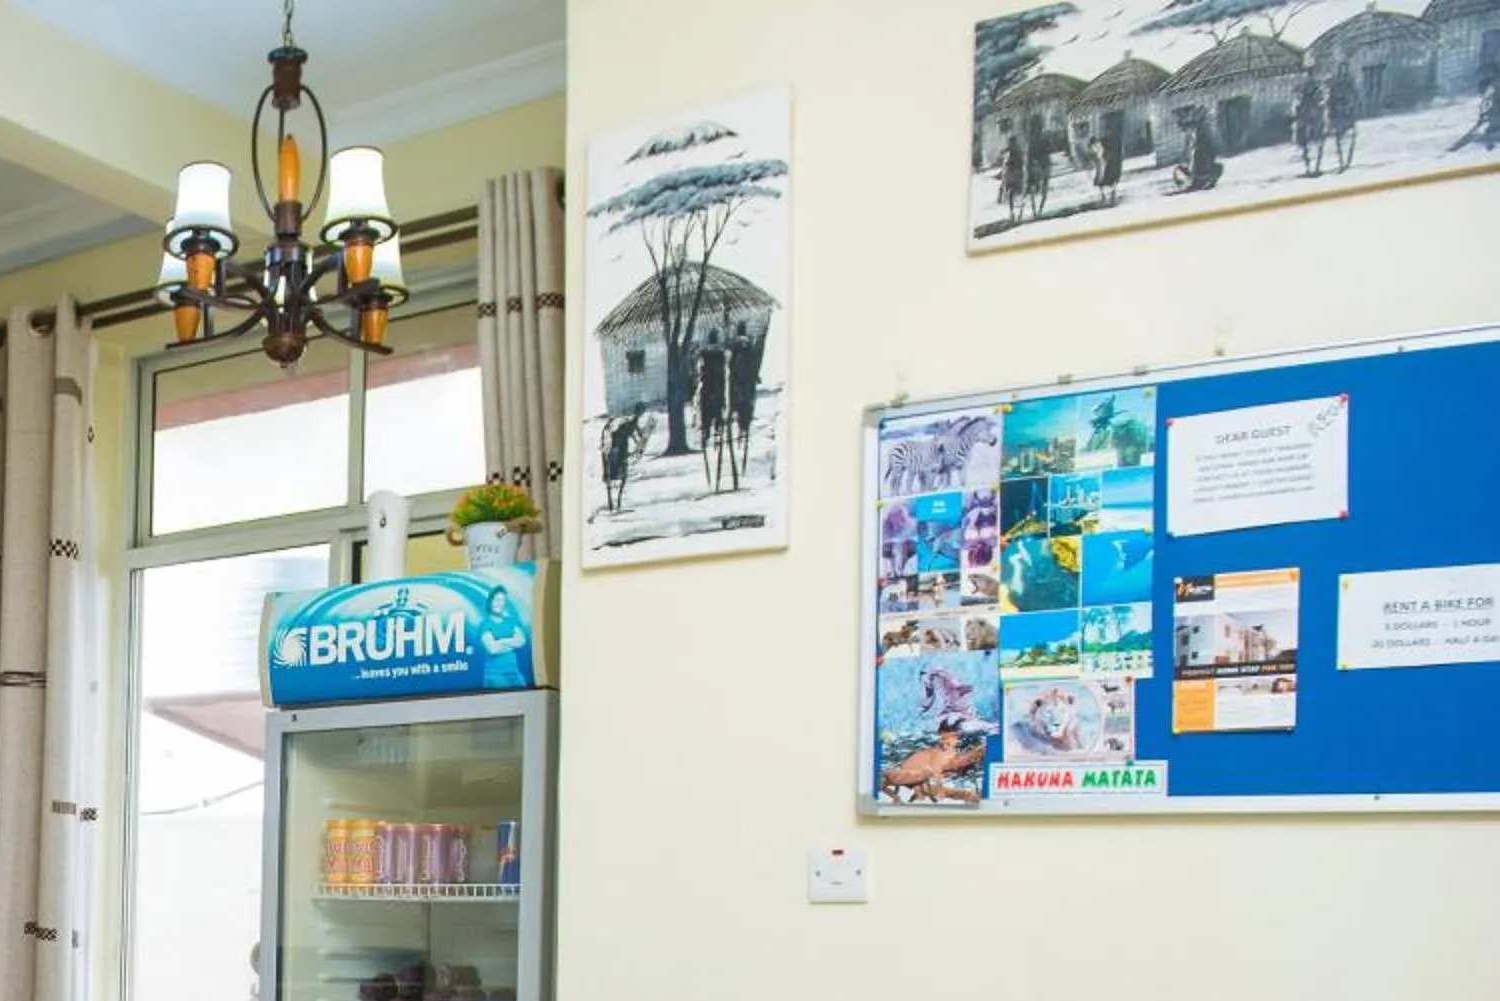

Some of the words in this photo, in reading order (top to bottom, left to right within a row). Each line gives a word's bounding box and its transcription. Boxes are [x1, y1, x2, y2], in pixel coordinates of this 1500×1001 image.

[1384, 601, 1418, 613] RENT
[1434, 599, 1464, 609] BIKE
[996, 769, 1075, 789] HAKUNA
[1081, 769, 1157, 787] MATATA
